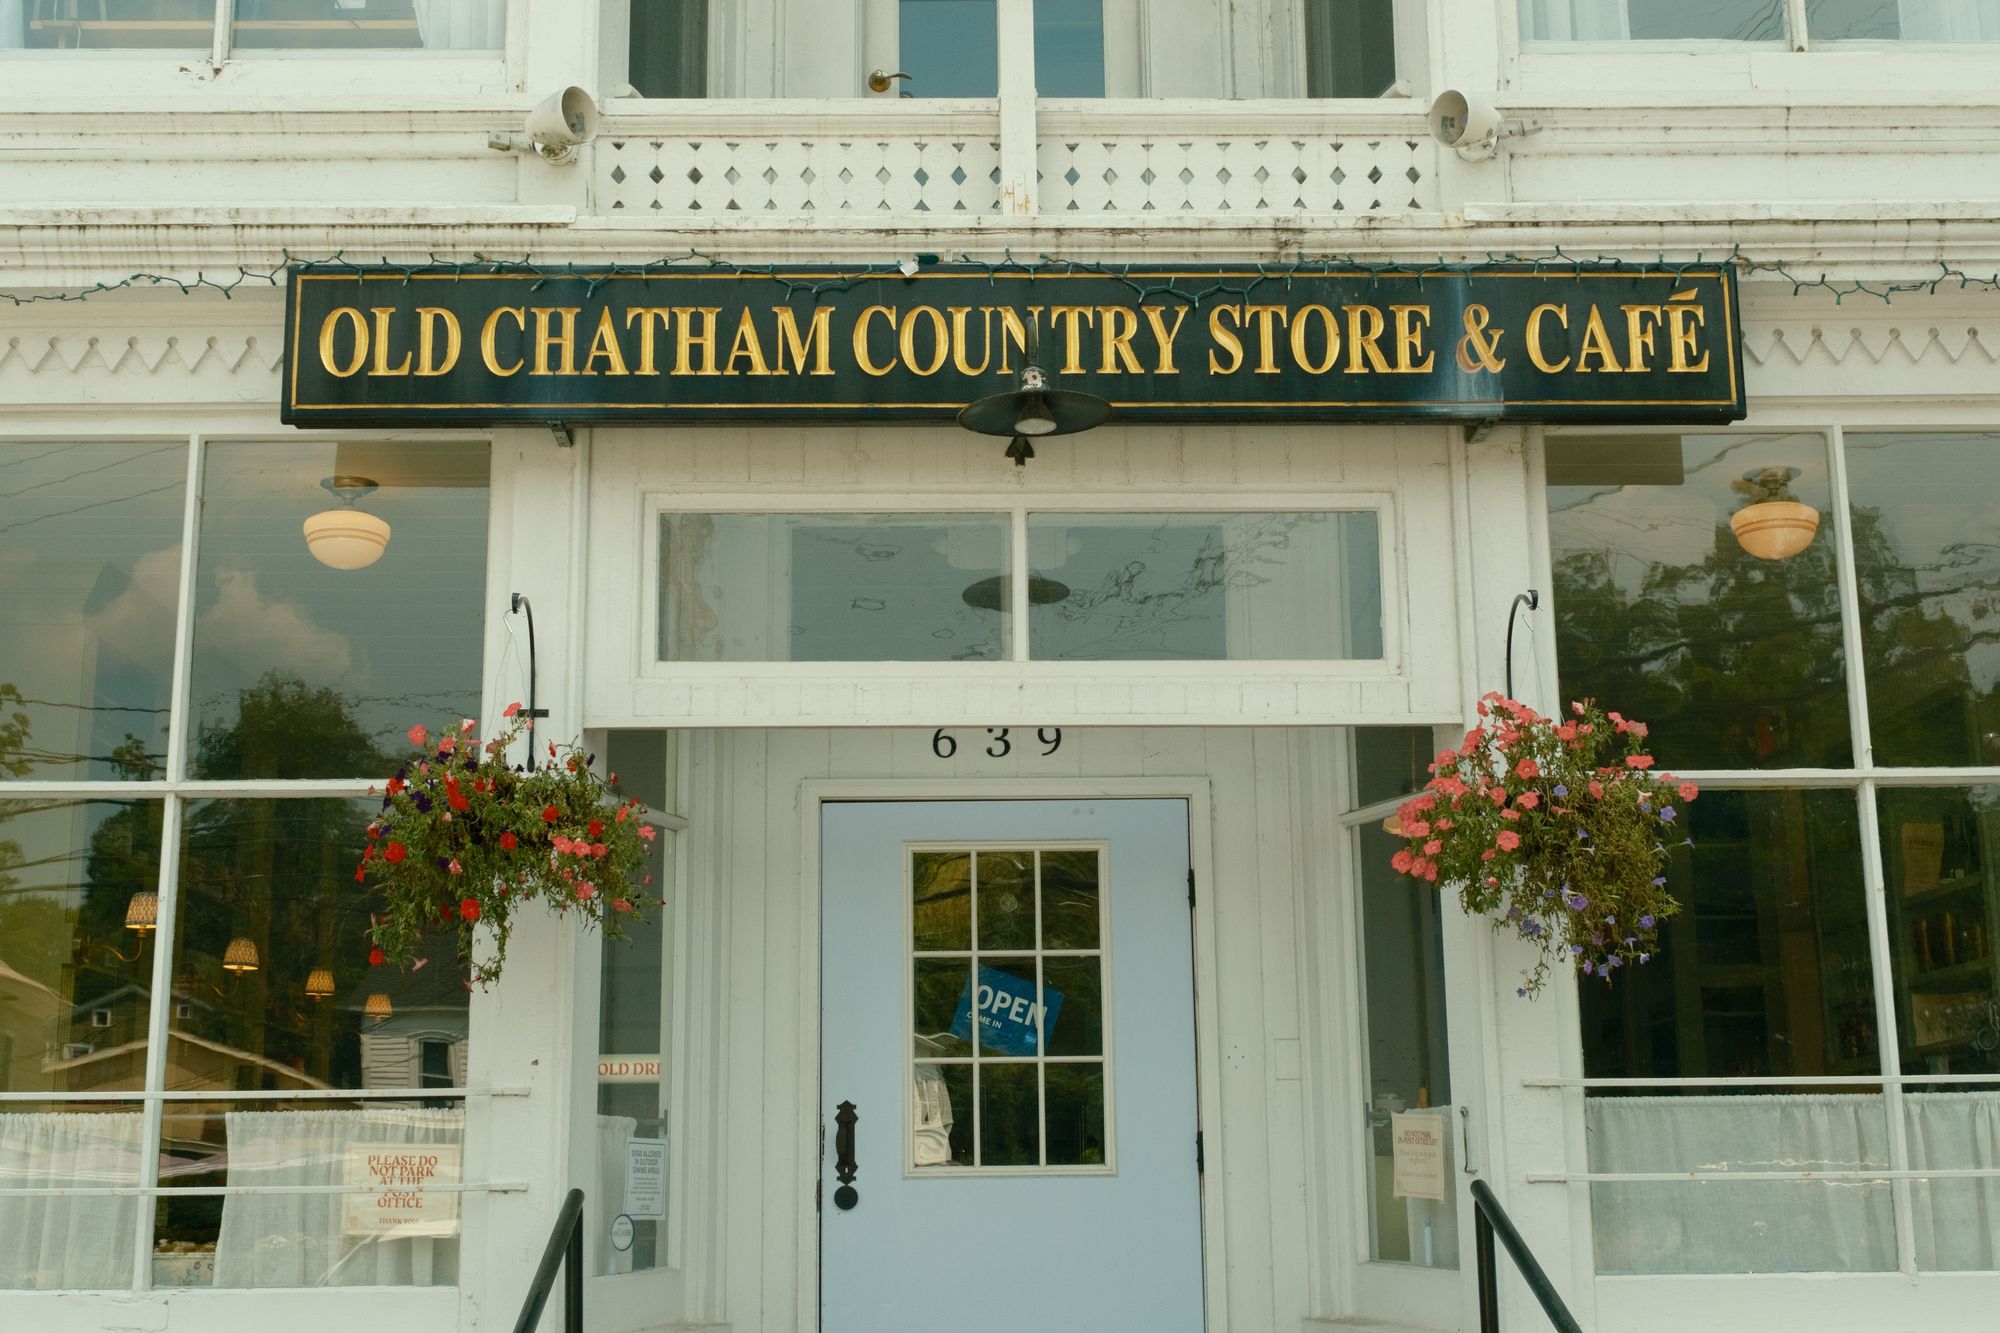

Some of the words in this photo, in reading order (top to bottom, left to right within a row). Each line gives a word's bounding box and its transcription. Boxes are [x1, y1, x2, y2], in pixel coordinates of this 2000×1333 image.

[318, 306, 462, 378] OLD
[480, 305, 836, 377] CHATHAM
[852, 304, 1189, 377] COUNTRY
[1208, 303, 1435, 376] STORE
[1456, 303, 1506, 374] &
[1525, 287, 1710, 374] CAFÉ
[932, 727, 1063, 759] 639
[977, 984, 1048, 1029] OPEN
[966, 1011, 992, 1026] CME
[992, 1020, 1002, 1029] IN
[598, 1062, 629, 1076] OLD
[367, 1154, 416, 1167] PLEASE
[419, 1155, 438, 1167] DO
[369, 1166, 397, 1177] NOT
[399, 1166, 435, 1177] PARK
[379, 1176, 396, 1185] AT
[398, 1176, 424, 1185] THE
[377, 1197, 423, 1209] OFFICE
[379, 1217, 402, 1225] THANK
